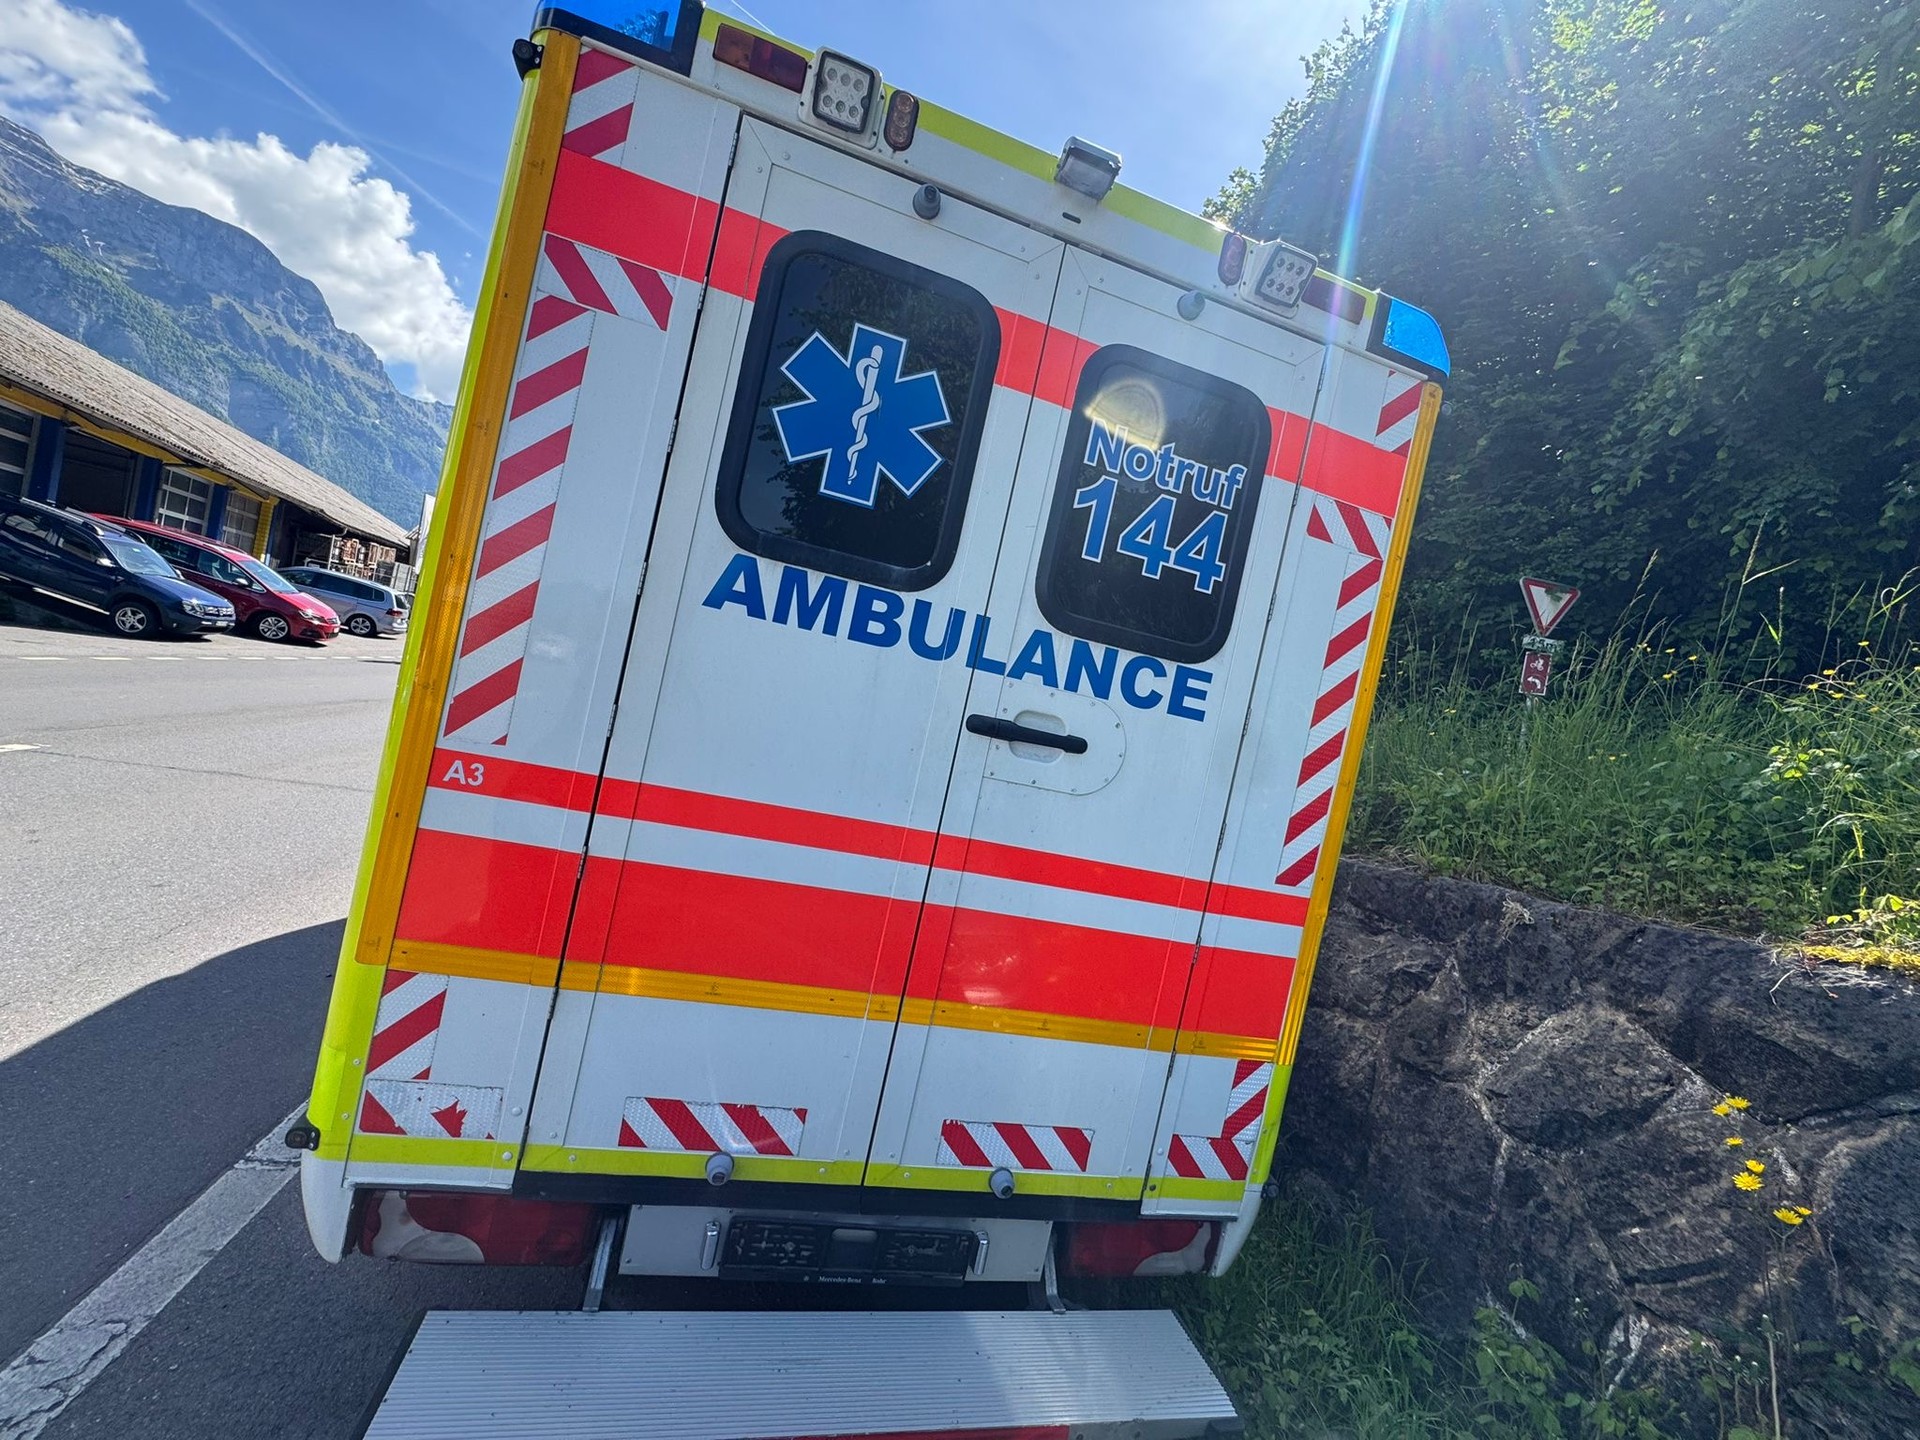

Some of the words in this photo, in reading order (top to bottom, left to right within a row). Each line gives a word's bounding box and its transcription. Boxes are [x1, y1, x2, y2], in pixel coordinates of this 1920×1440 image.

[1083, 417, 1248, 510] Notruf
[1073, 475, 1229, 595] 144
[701, 553, 1214, 722] AMBULANCE
[442, 759, 485, 786] A3
